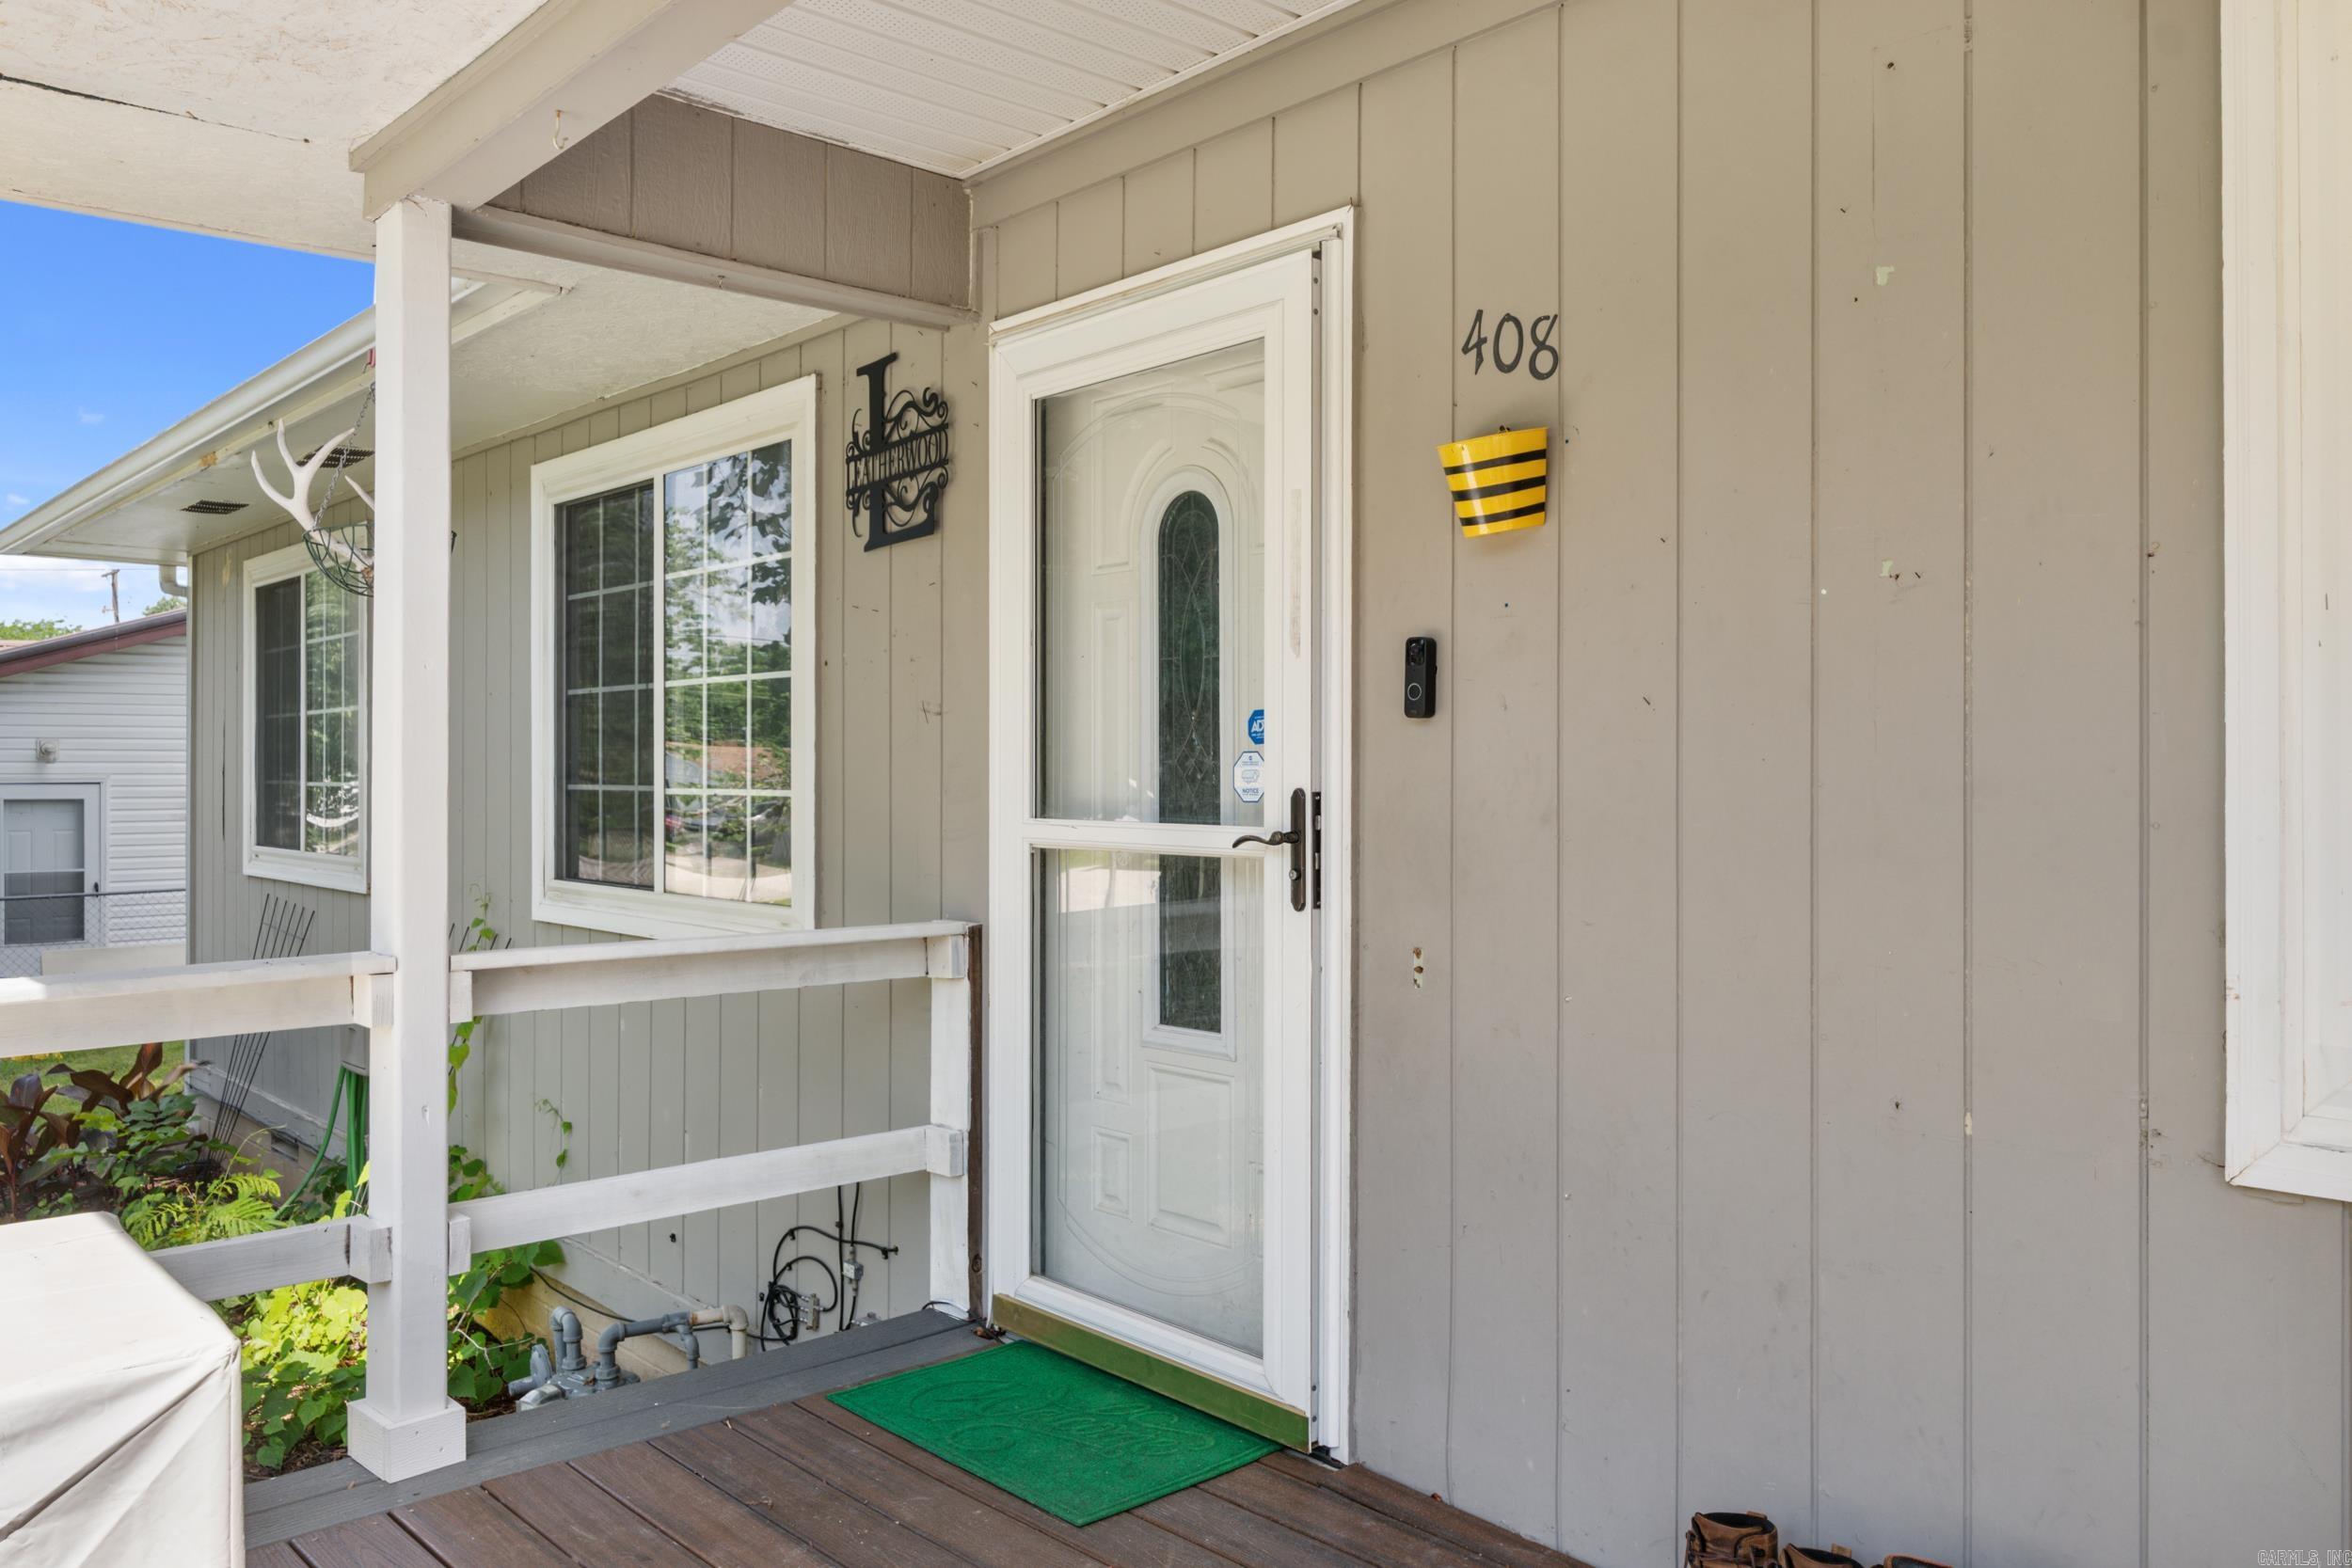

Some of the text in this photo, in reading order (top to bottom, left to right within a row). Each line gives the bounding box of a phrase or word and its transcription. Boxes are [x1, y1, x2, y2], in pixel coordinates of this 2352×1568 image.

[1461, 309, 1559, 381] 408
[846, 428, 948, 488] LEATHERWOOD
[1251, 720, 1264, 733] AD
